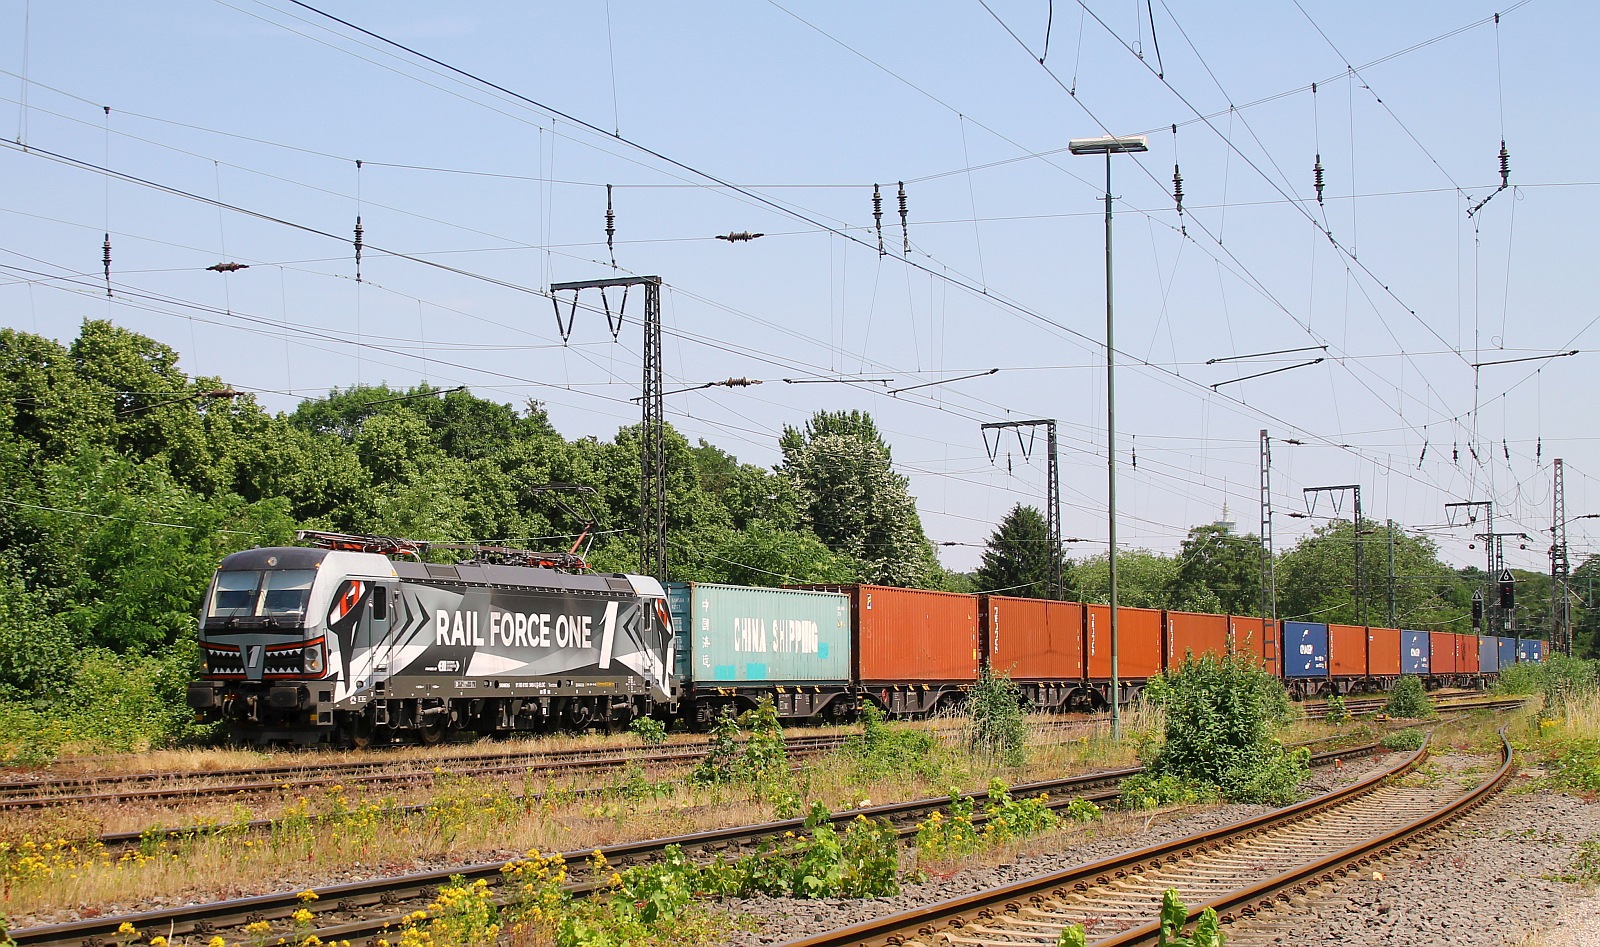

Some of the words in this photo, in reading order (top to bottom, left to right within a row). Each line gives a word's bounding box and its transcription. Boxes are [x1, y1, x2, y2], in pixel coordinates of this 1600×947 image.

[1503, 571, 1509, 580] 6
[436, 609, 485, 646] RAIL
[490, 612, 551, 647] FORCE
[555, 614, 592, 648] ONE
[734, 617, 767, 653] CHINA
